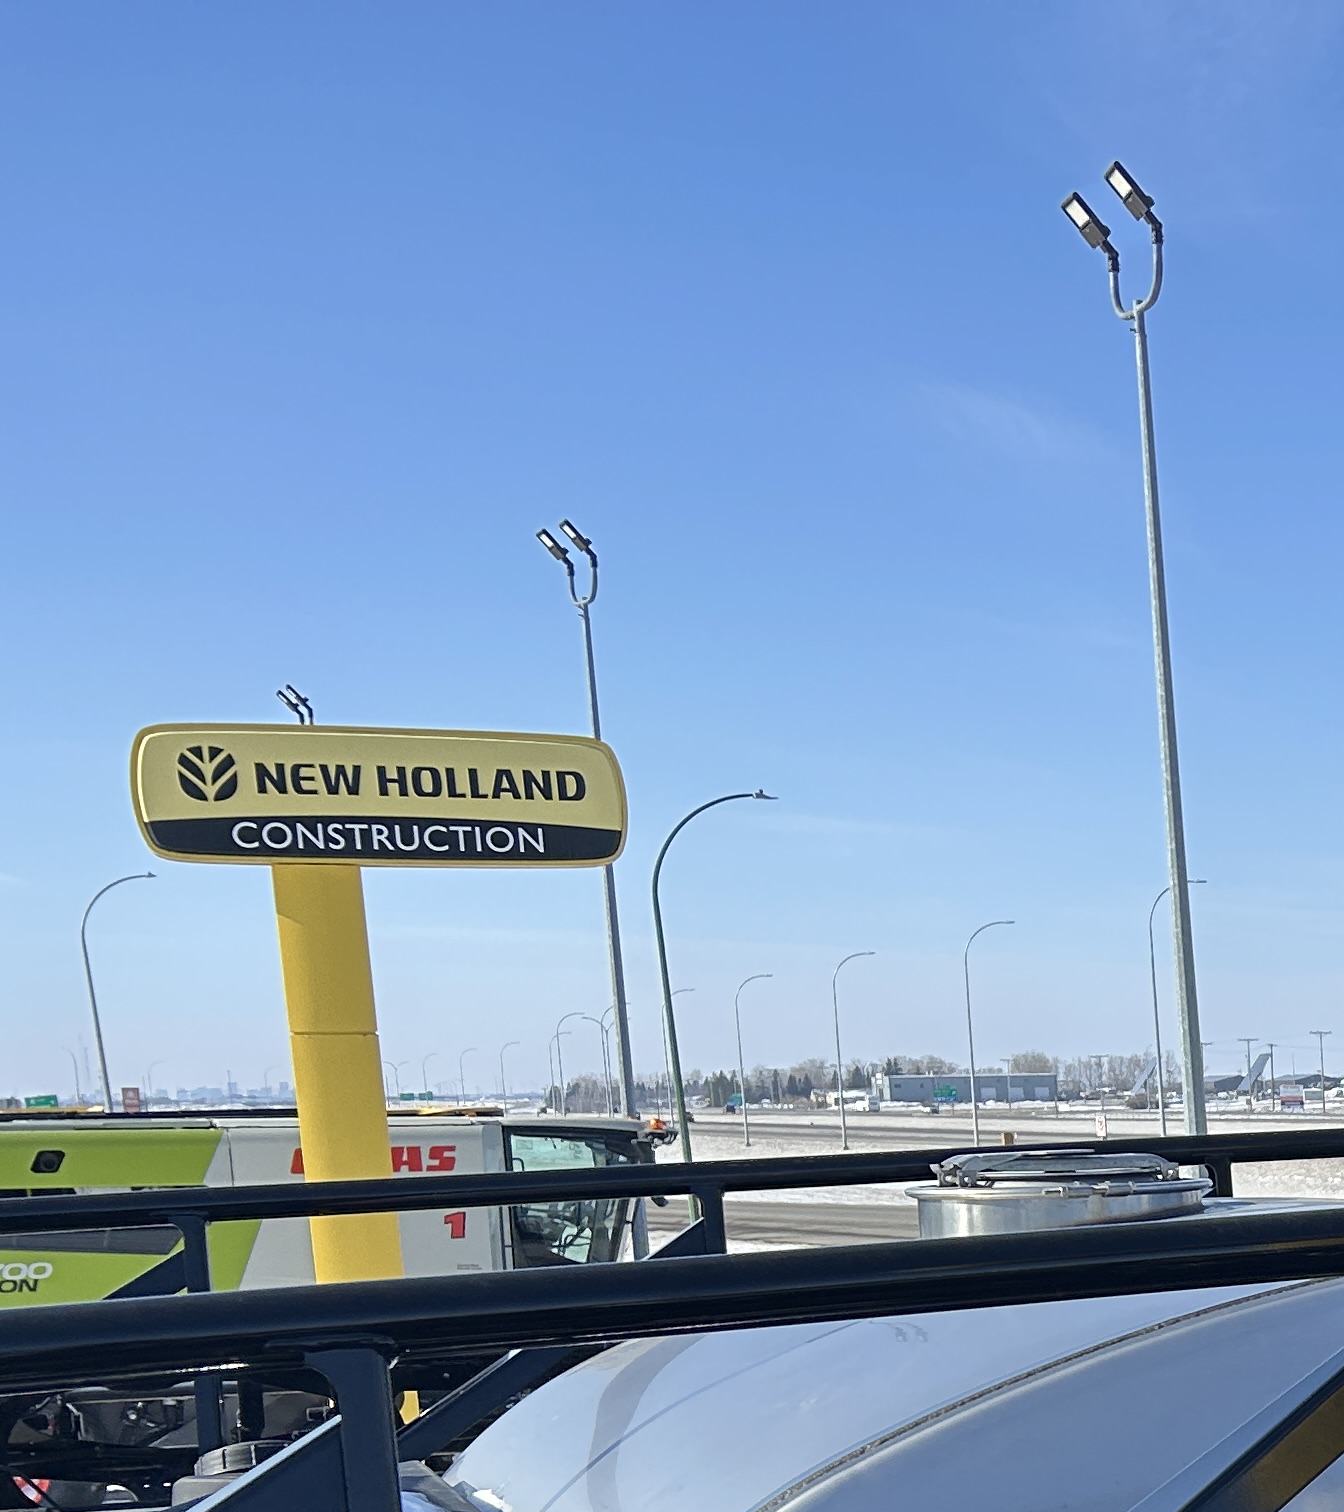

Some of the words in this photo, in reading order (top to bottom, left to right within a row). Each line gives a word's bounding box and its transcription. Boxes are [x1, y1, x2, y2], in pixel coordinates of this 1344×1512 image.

[254, 762, 361, 796] NEW
[376, 765, 587, 801] HOLLAND
[231, 821, 545, 853] CONSTRUCTION
[444, 1211, 467, 1239] 1
